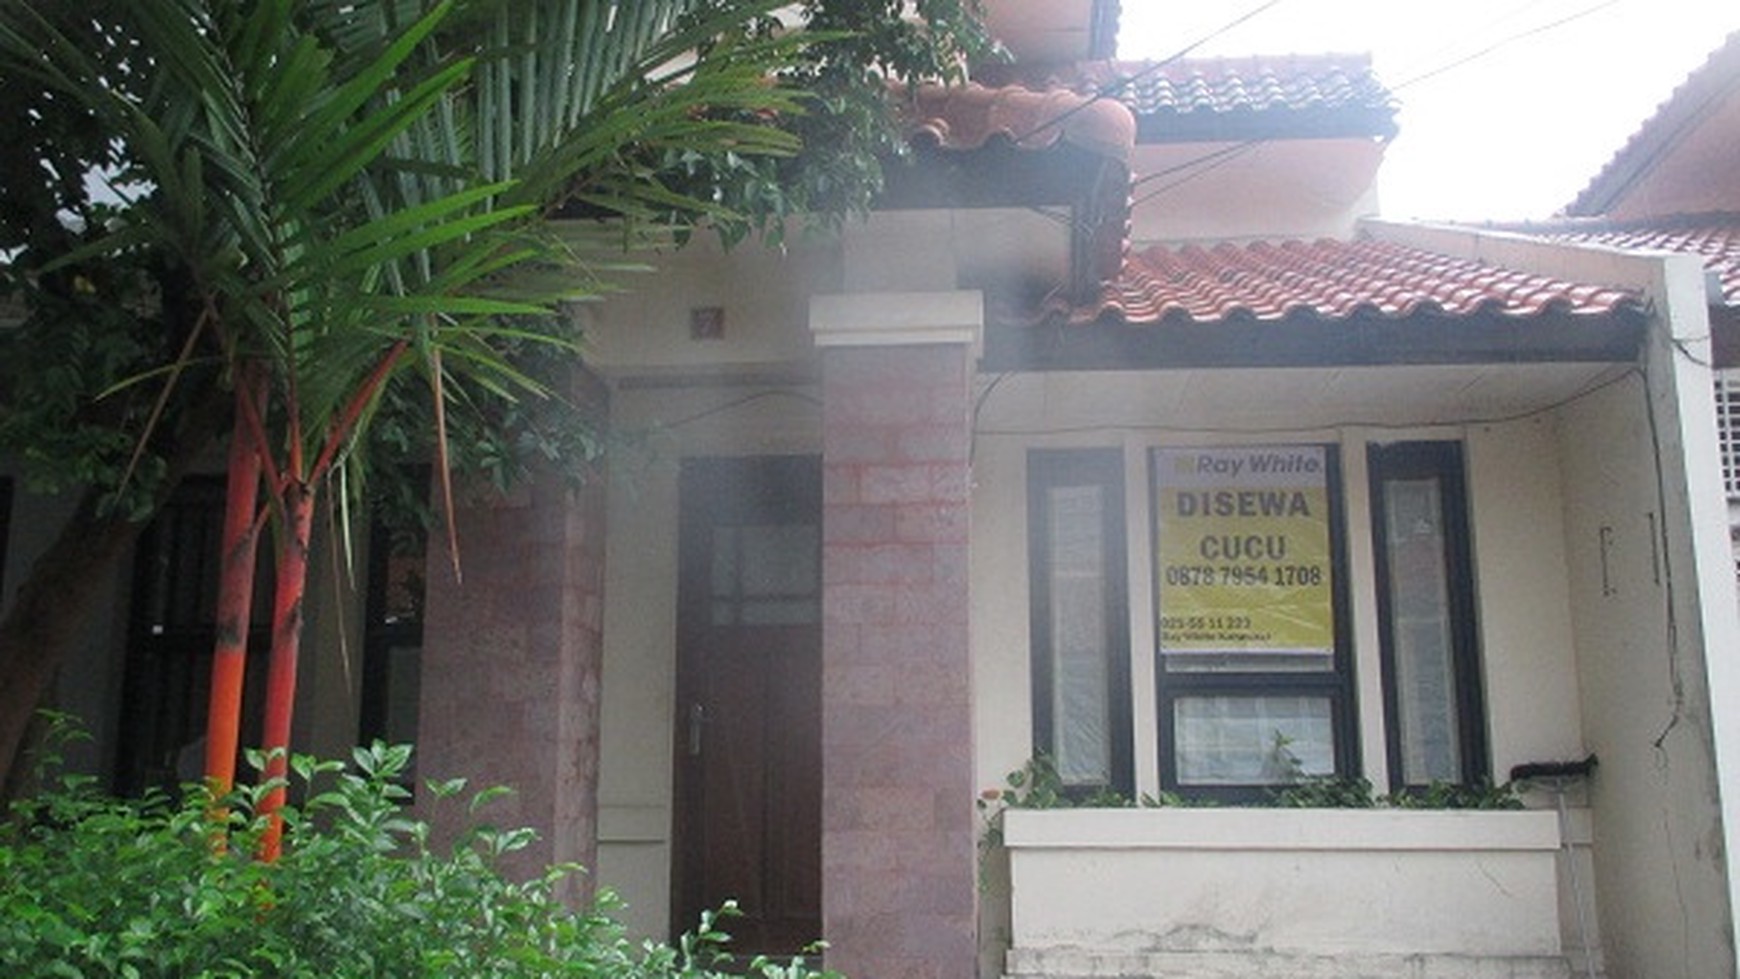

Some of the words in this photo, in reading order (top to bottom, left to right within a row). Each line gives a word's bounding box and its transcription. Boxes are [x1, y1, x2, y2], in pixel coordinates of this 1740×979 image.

[1197, 455, 1244, 477] Ray
[1251, 454, 1320, 473] White
[1177, 491, 1311, 517] DISEWA
[1200, 535, 1286, 561] CUCU
[1166, 567, 1214, 586] 0878
[1274, 566, 1322, 586] 1708
